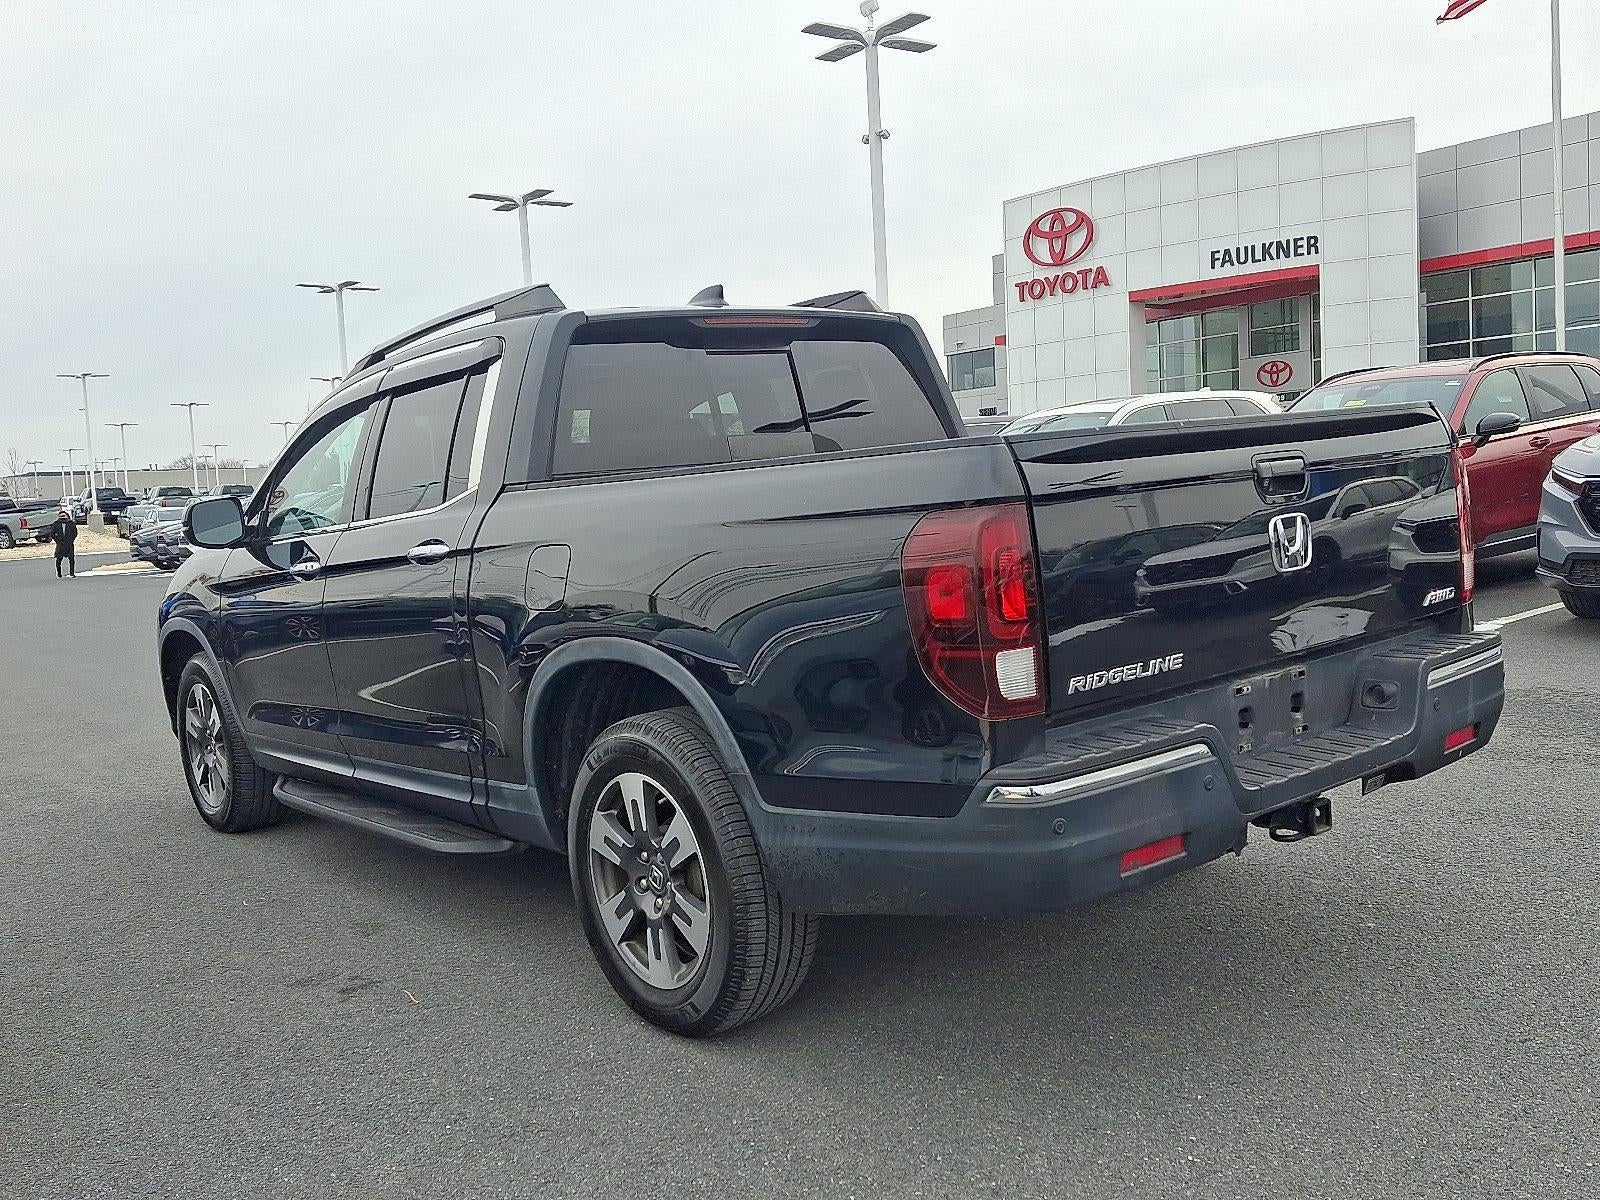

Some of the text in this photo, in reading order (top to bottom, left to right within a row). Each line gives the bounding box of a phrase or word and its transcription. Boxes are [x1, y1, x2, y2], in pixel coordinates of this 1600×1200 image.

[1210, 235, 1320, 270] FAULKNER
[1015, 265, 1110, 303] TOYOTA
[1067, 652, 1184, 696] RIDGELINE
